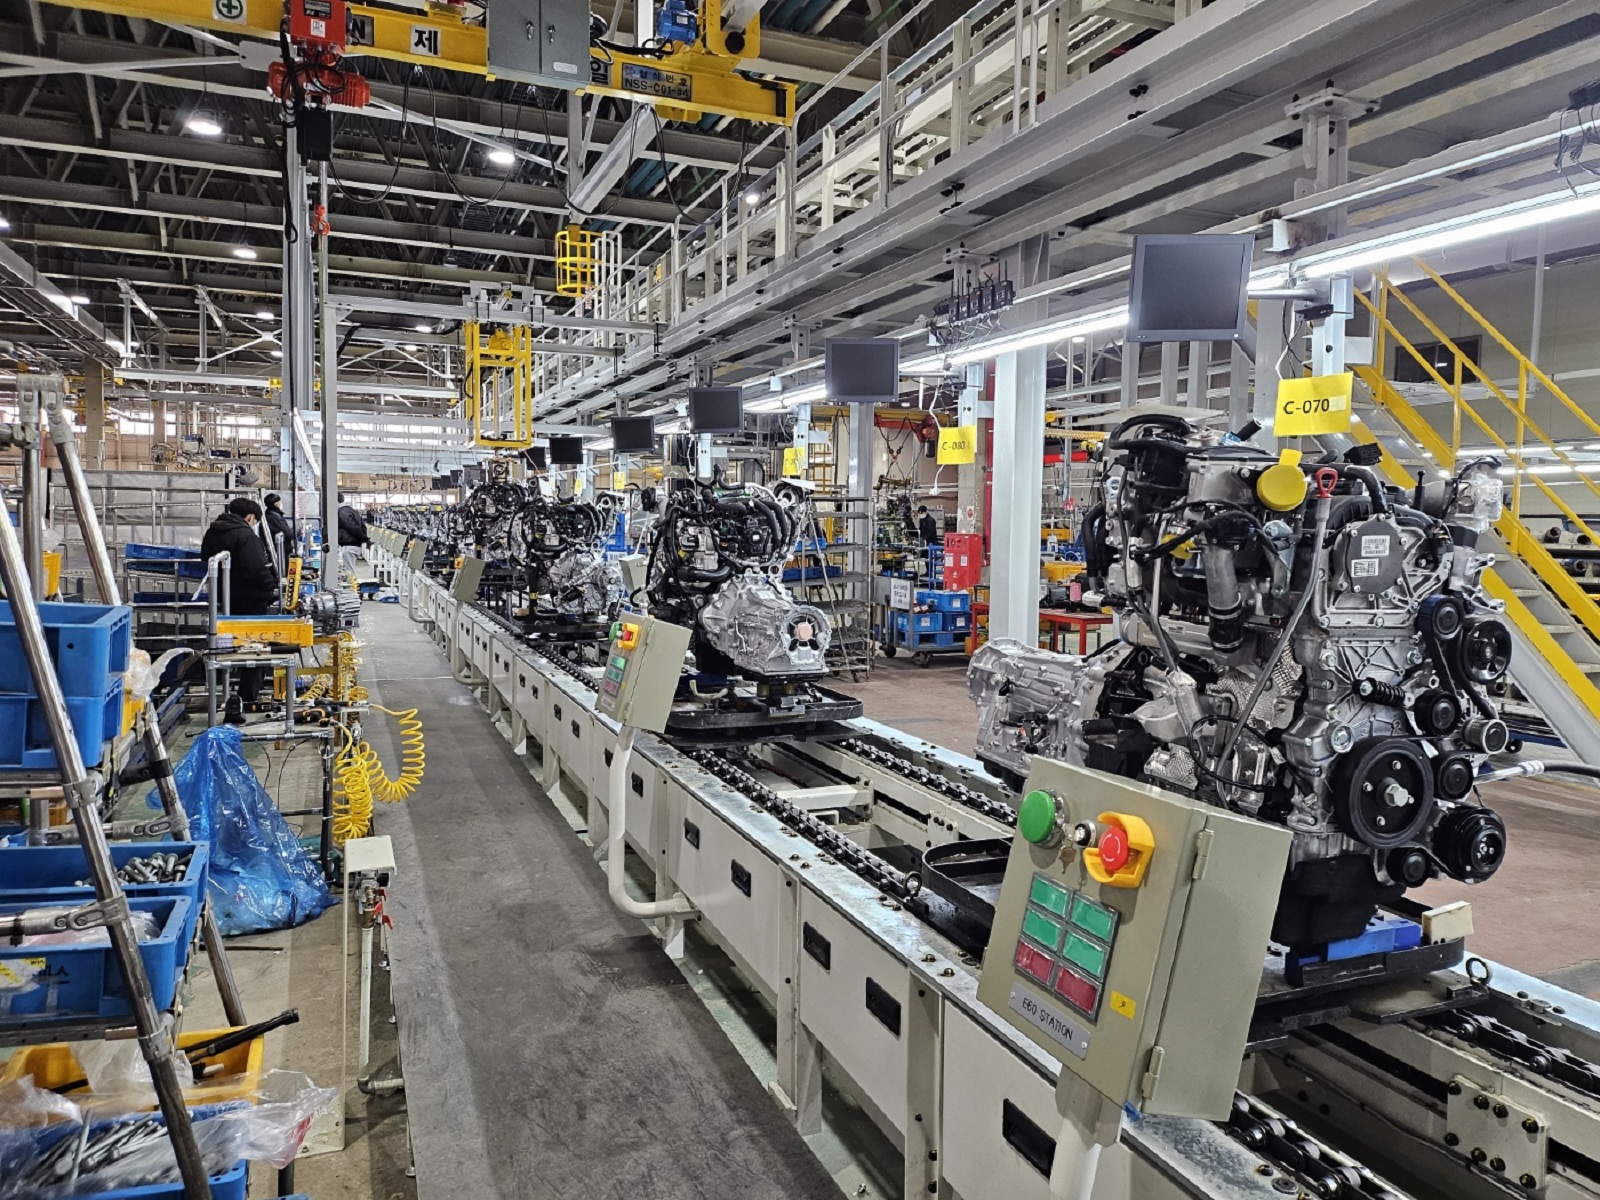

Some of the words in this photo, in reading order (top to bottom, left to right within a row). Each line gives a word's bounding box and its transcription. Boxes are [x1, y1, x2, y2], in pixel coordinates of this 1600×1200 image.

[414, 29, 439, 56] 제
[590, 60, 609, 86] 일
[1283, 398, 1330, 415] C-070
[1022, 997, 1038, 1016] E60
[1039, 1009, 1074, 1042] STATION
